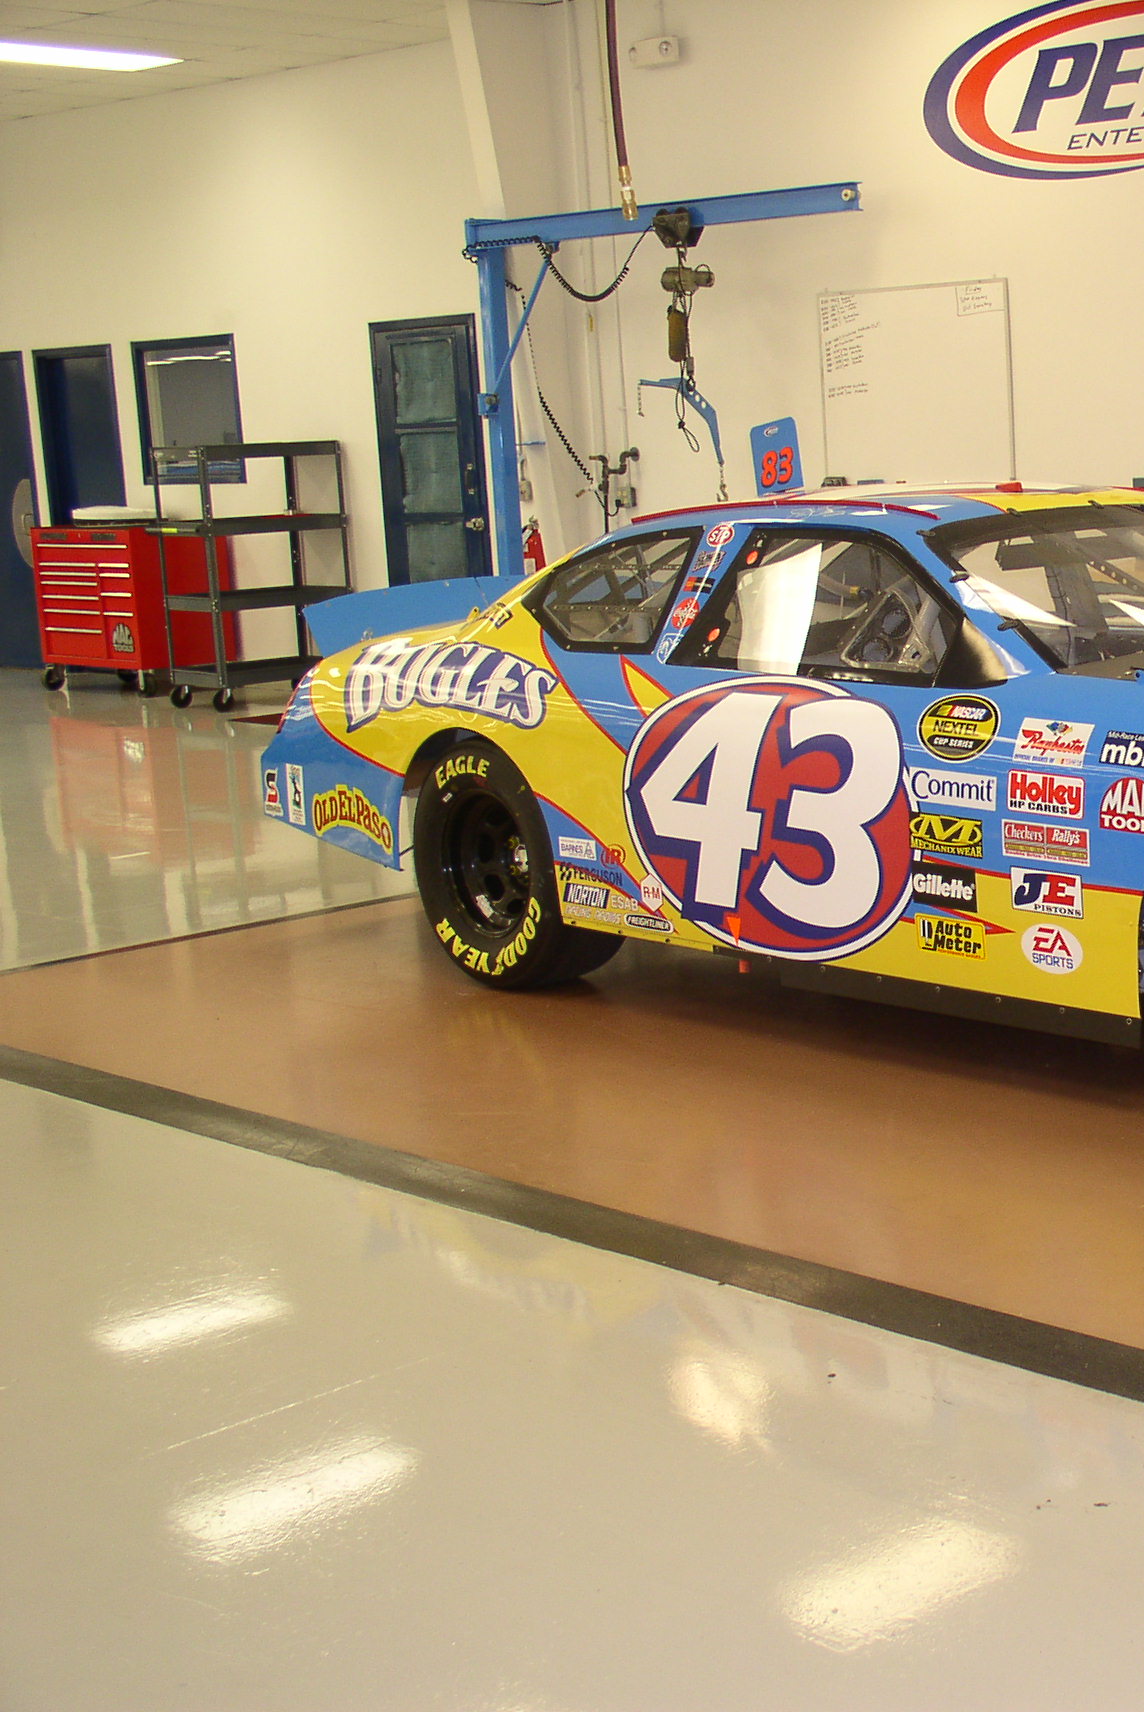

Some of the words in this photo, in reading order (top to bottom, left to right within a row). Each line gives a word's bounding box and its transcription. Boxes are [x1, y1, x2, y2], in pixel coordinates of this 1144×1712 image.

[761, 446, 794, 488] 83
[709, 527, 731, 544] STP
[345, 636, 559, 731] BUGLES
[951, 705, 989, 720] NASCAR
[933, 719, 979, 736] NEXTEL
[933, 738, 949, 746] CUP
[950, 739, 973, 749] SERIES
[435, 755, 490, 789] EAGLE
[912, 770, 992, 802] Commit
[1011, 772, 1081, 815] Holley
[314, 795, 338, 832] OLD
[338, 790, 355, 821] EL
[640, 691, 901, 929] 43
[1010, 799, 1025, 809] HP
[1027, 802, 1068, 814] CARBS
[1005, 823, 1043, 842] Checkers
[1052, 828, 1080, 846] Rally's
[957, 846, 982, 858] WEAR
[567, 883, 607, 909] NORTON
[913, 873, 973, 901] Gillette
[1014, 873, 1076, 907] JE
[611, 895, 639, 911] ESAB
[1034, 903, 1082, 917] PISTONS
[935, 920, 972, 938] Auto
[934, 934, 982, 954] Meter
[1032, 927, 1072, 957] EA
[1032, 952, 1074, 969] SPORTS
